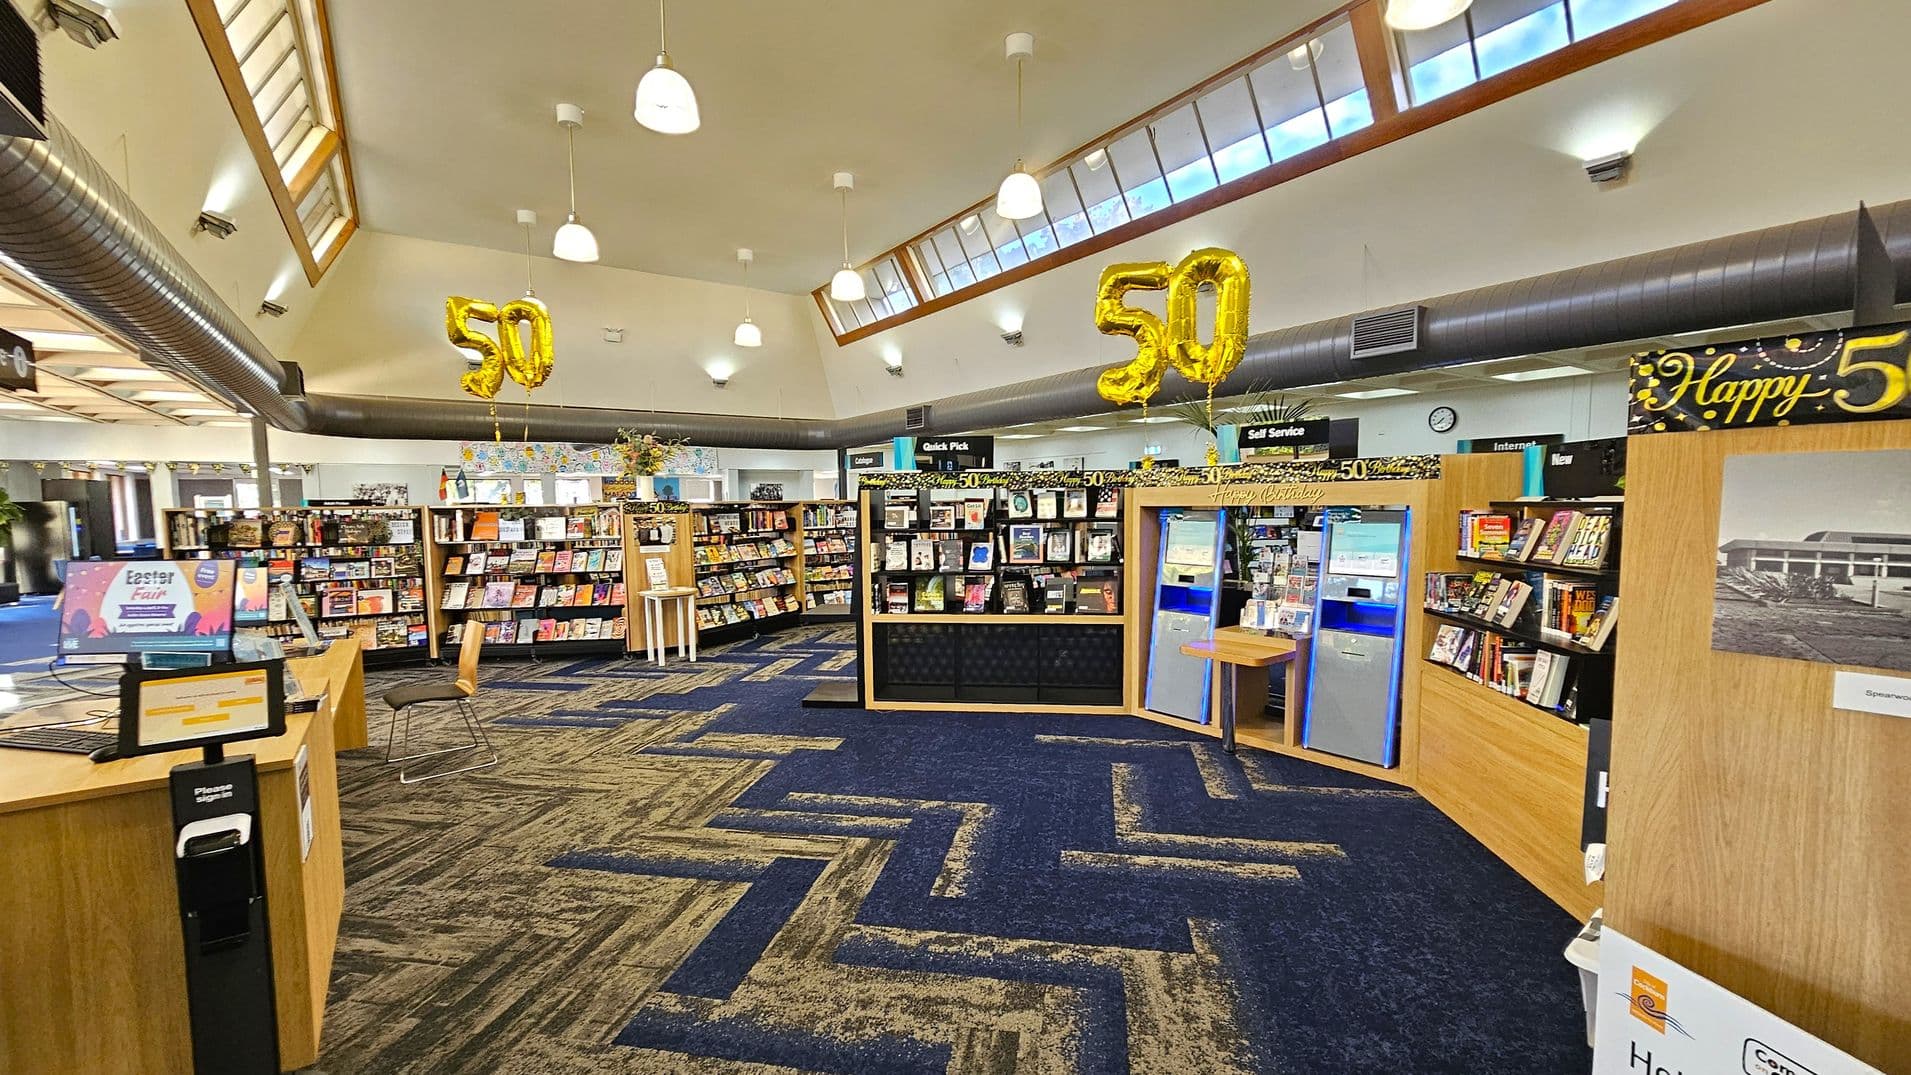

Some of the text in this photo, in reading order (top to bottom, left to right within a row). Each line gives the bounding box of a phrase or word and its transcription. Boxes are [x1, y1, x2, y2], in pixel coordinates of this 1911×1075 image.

[1095, 247, 1251, 405] 50
[446, 296, 553, 398] 50
[1644, 330, 1911, 424] Happy 5
[1247, 426, 1305, 439] Self Service
[922, 442, 969, 452] Quick Pick
[1551, 453, 1574, 466] New
[1201, 466, 1222, 483] 50
[1340, 458, 1367, 480] 50
[958, 472, 979, 488] 50
[1082, 471, 1105, 487] 50
[1208, 481, 1325, 505] Happy Birthday
[649, 502, 665, 514] 50
[126, 570, 175, 585] Easter
[130, 586, 167, 600] Fair
[1864, 689, 1911, 702] Spearwo
[193, 783, 233, 796] Please
[196, 791, 233, 804] sign in
